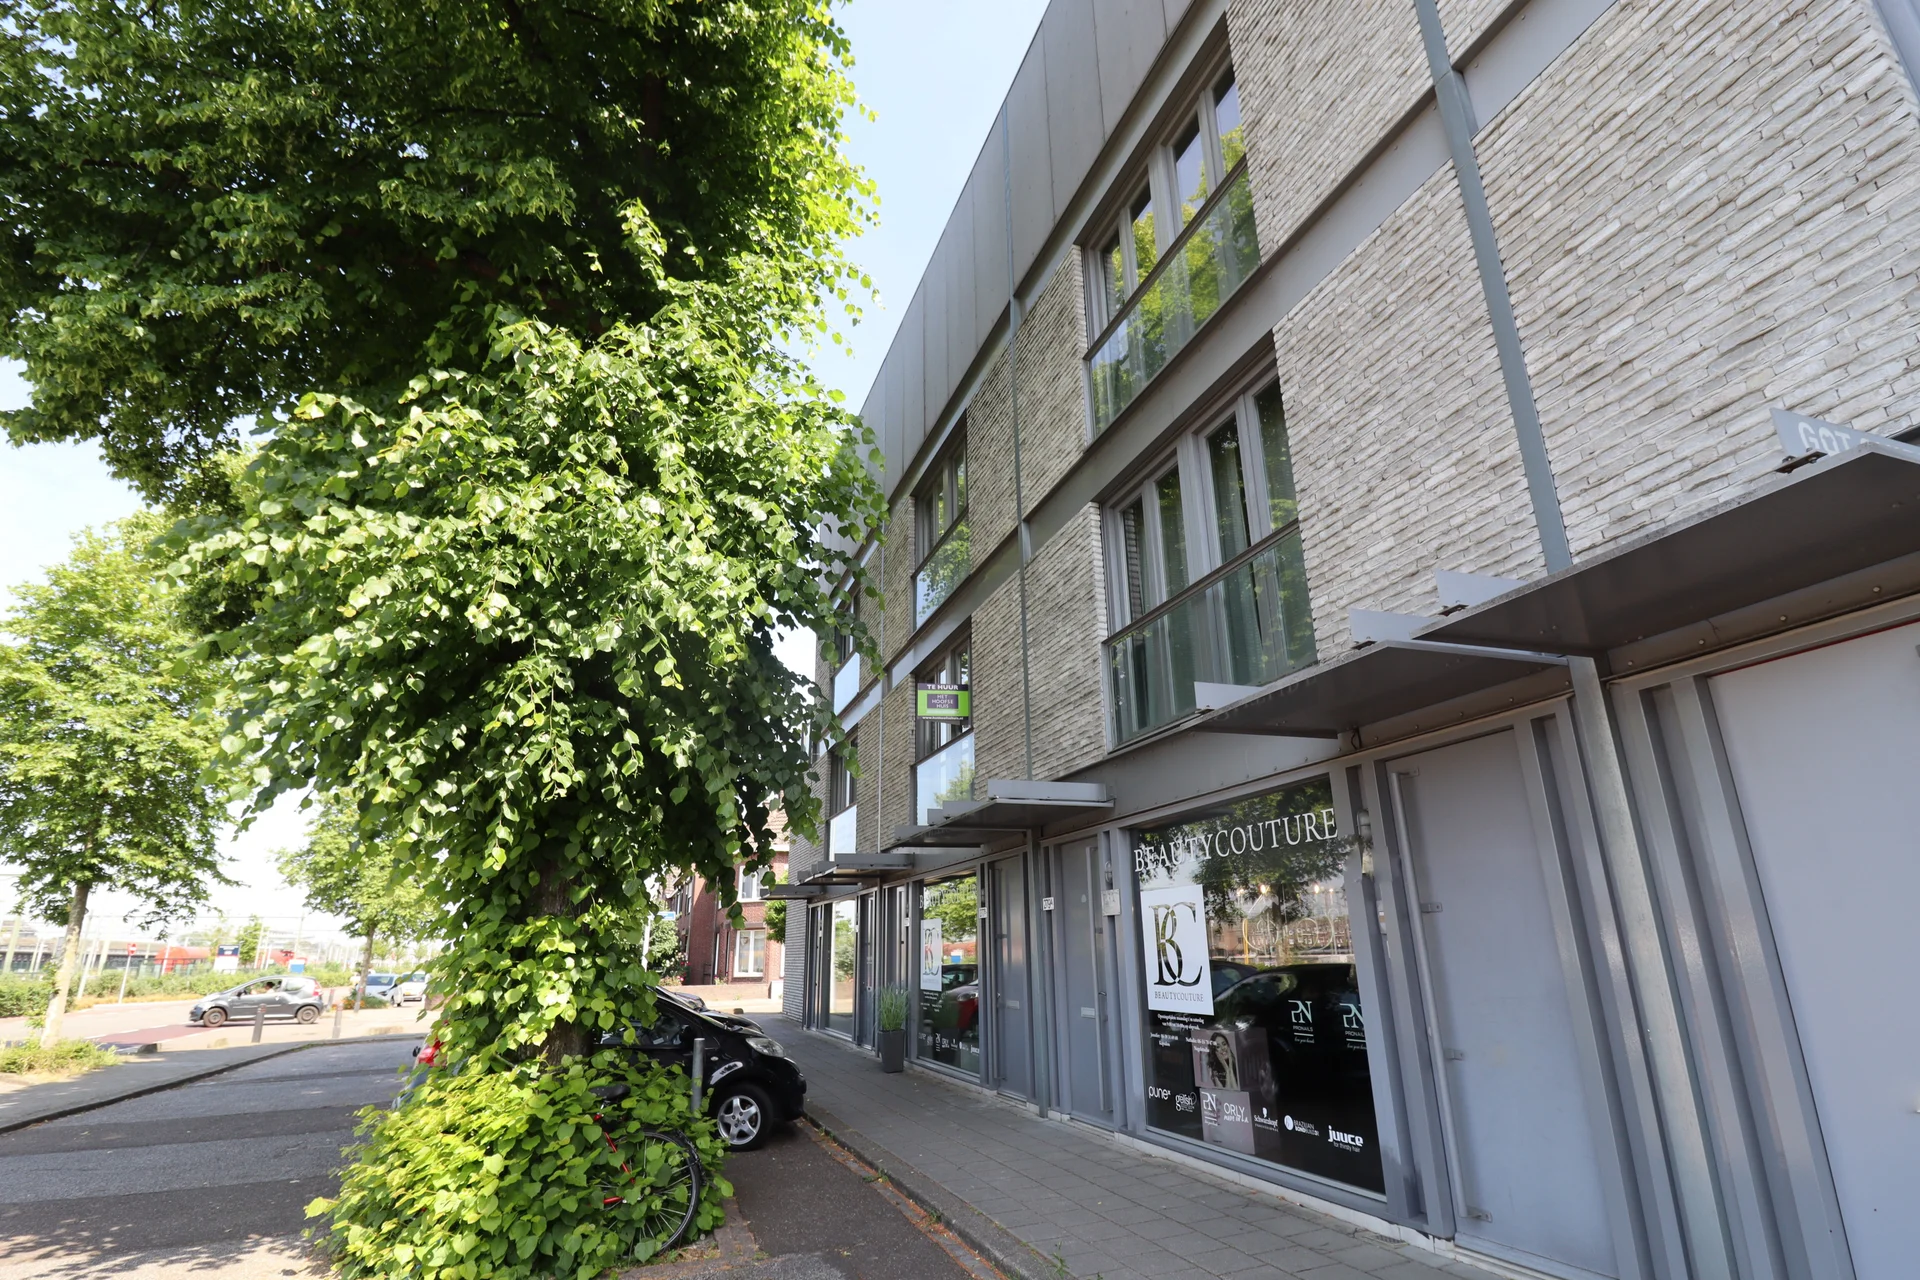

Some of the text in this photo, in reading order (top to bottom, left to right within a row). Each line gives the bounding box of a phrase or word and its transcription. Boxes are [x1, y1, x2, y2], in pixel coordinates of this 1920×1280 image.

[1134, 808, 1338, 872] BEAUTYCOUTURE
[1154, 990, 1204, 1003] BEAUTYCOUTURE
[1223, 1102, 1245, 1122] ORLY
[1328, 1125, 1364, 1147] juuce
